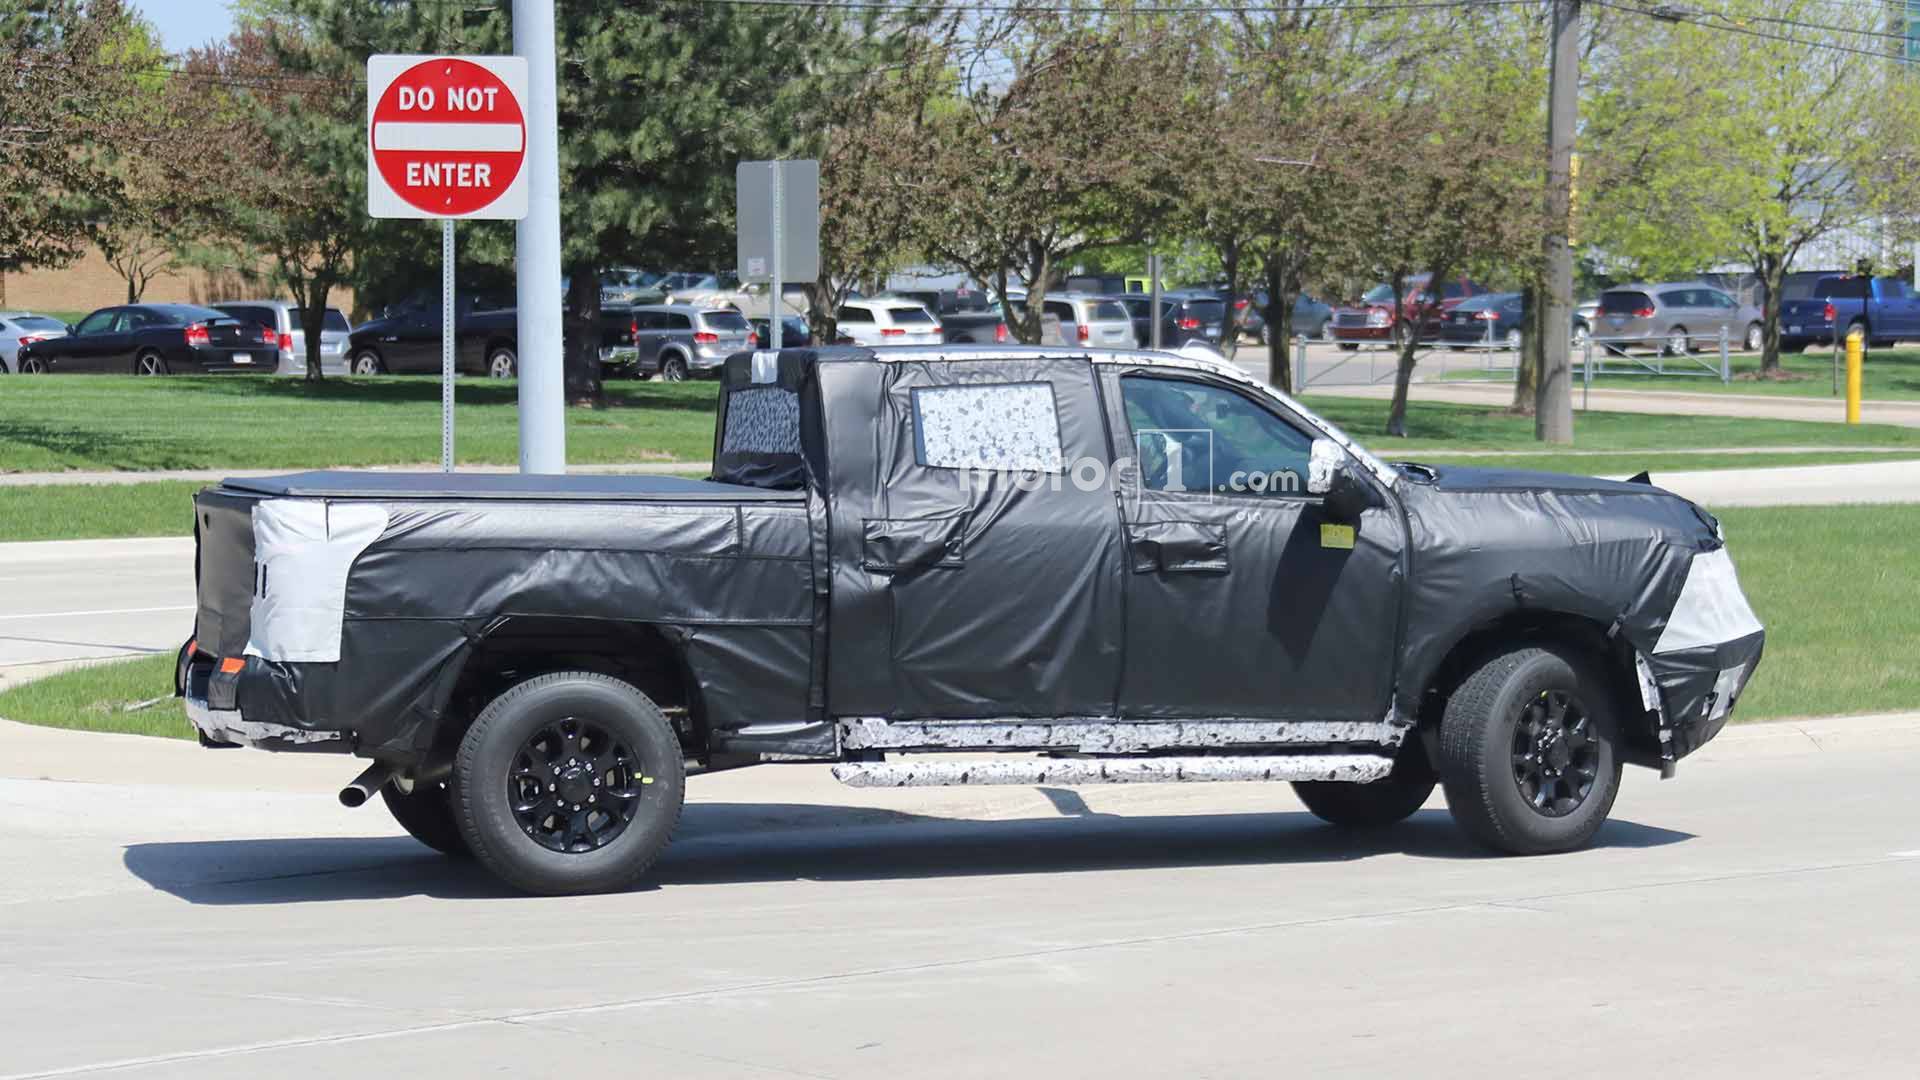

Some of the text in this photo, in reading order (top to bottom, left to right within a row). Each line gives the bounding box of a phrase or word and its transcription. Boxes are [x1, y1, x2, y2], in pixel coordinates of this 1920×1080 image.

[399, 86, 498, 111] DO NOT
[406, 162, 491, 187] ENTER
